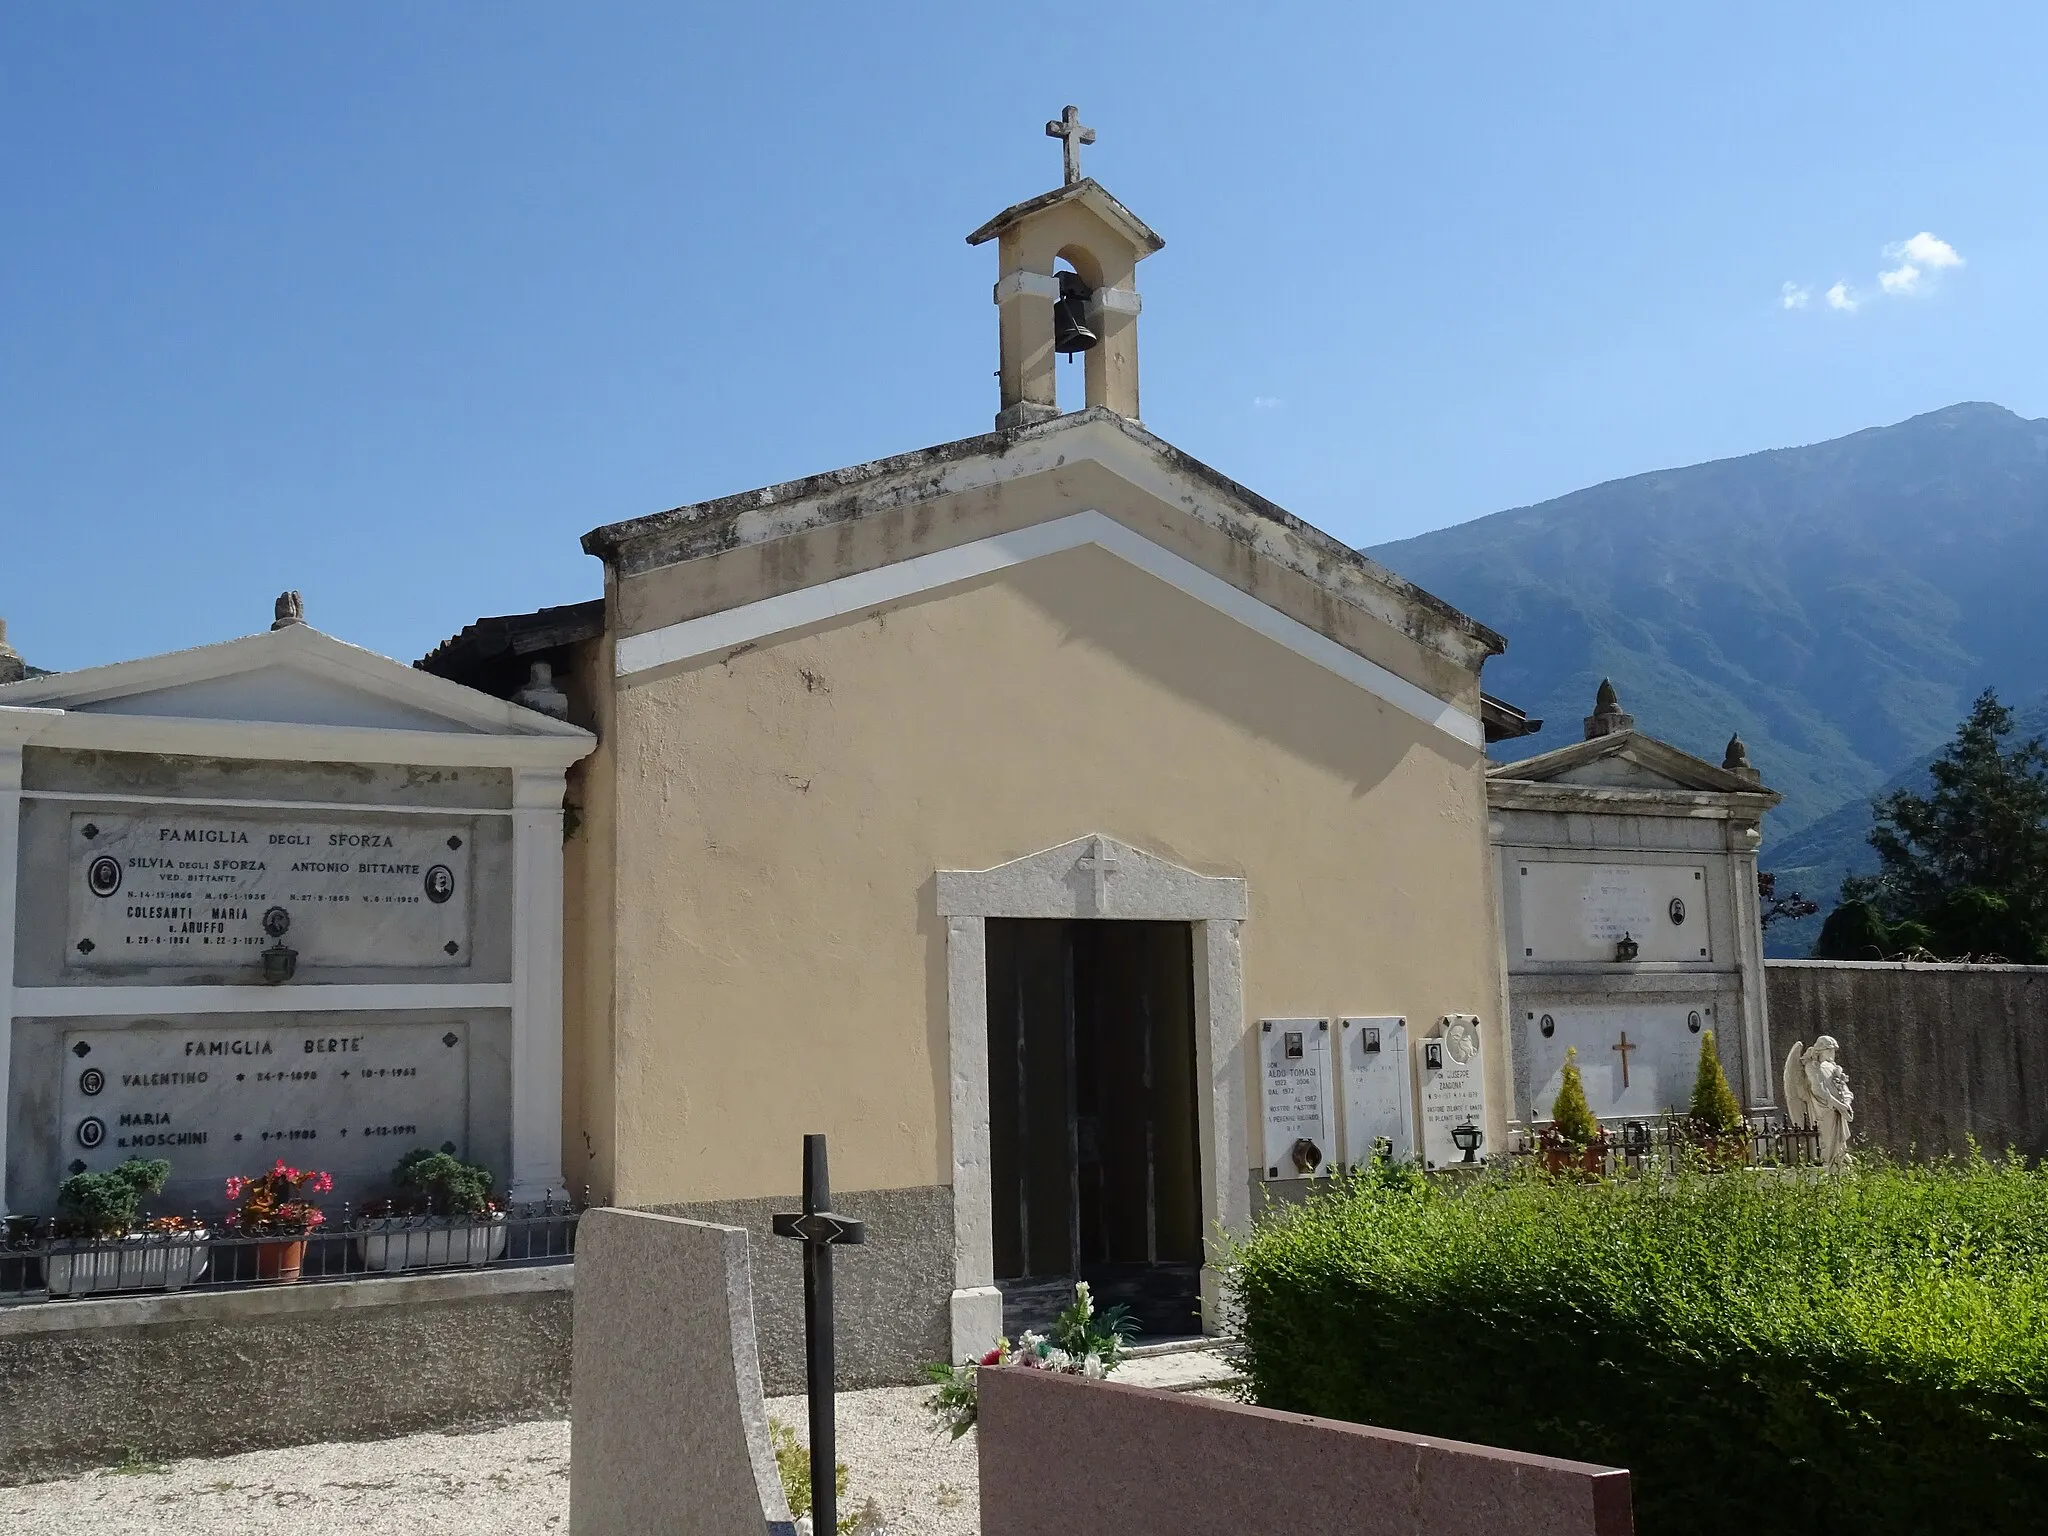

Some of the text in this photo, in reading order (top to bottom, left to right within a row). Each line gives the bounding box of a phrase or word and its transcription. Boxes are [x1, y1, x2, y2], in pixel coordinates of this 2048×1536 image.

[159, 828, 393, 848] FAMIGLIA DEGLI SFORZA
[128, 857, 266, 870] SILVIA DEGLI SFORZA
[291, 862, 420, 874] ANTONIO BITTANTE
[159, 873, 237, 882] VED. BITTANTE
[126, 906, 248, 920] COLESANTI MARIA
[181, 921, 224, 934] ARUFFO
[185, 1040, 273, 1056] FAMIGLIA
[122, 1071, 208, 1087] VALENTINO
[1268, 1068, 1316, 1078] ALDO TOMASI
[119, 1112, 171, 1126] MARIA
[131, 1131, 207, 1147] MOSCHINI
